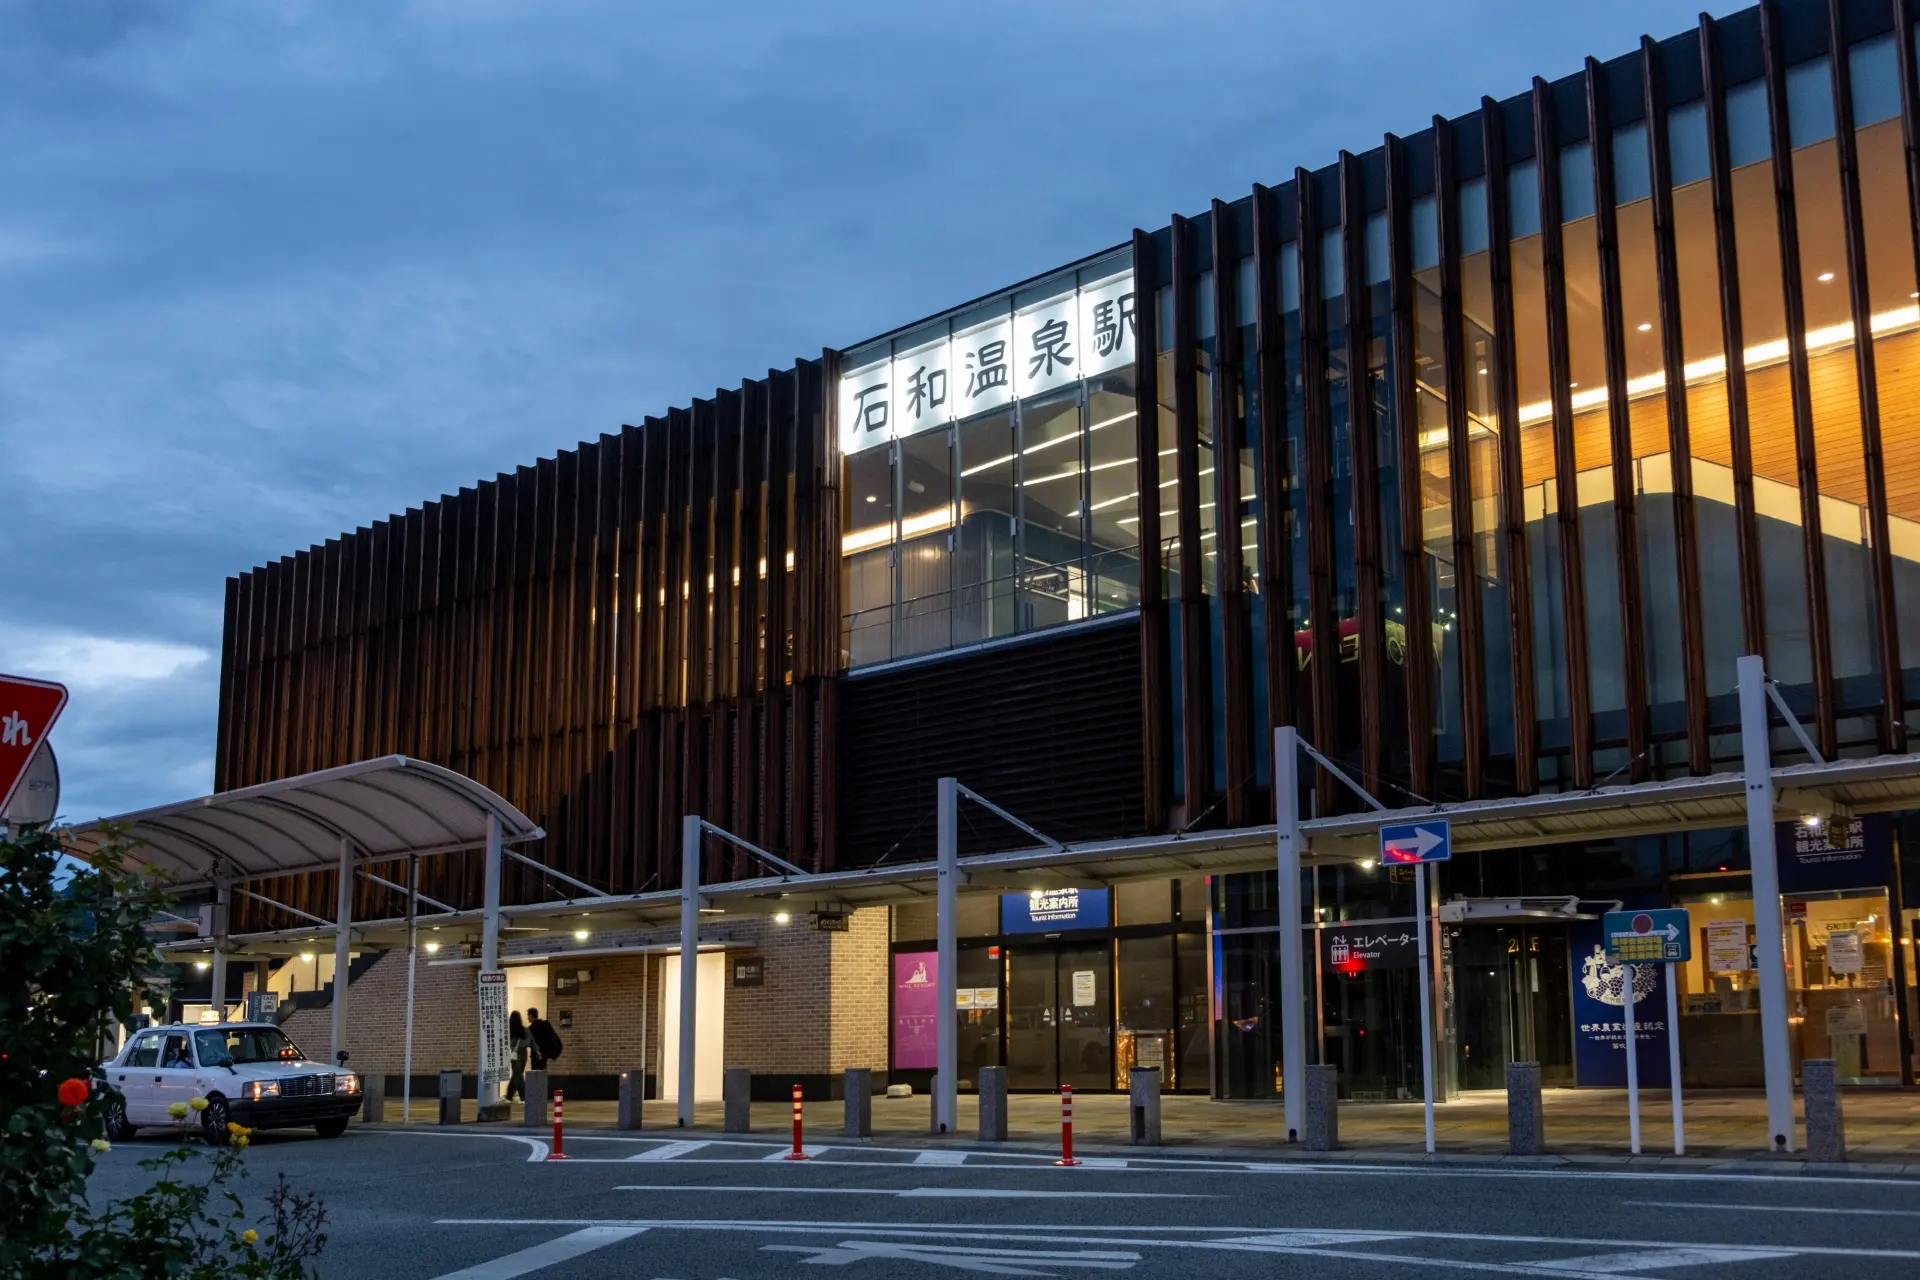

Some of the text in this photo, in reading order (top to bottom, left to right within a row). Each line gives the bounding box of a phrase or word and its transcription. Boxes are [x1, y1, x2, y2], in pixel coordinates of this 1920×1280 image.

[852, 292, 1136, 434] 石和温泉駅
[2, 710, 32, 746] れ
[1029, 896, 1078, 911] 観光案内所
[1031, 913, 1076, 922] Tourist Information
[1352, 933, 1419, 948] エレベーター
[1353, 951, 1381, 959] Elevator
[1580, 1021, 1665, 1032] 世界農業産認定
